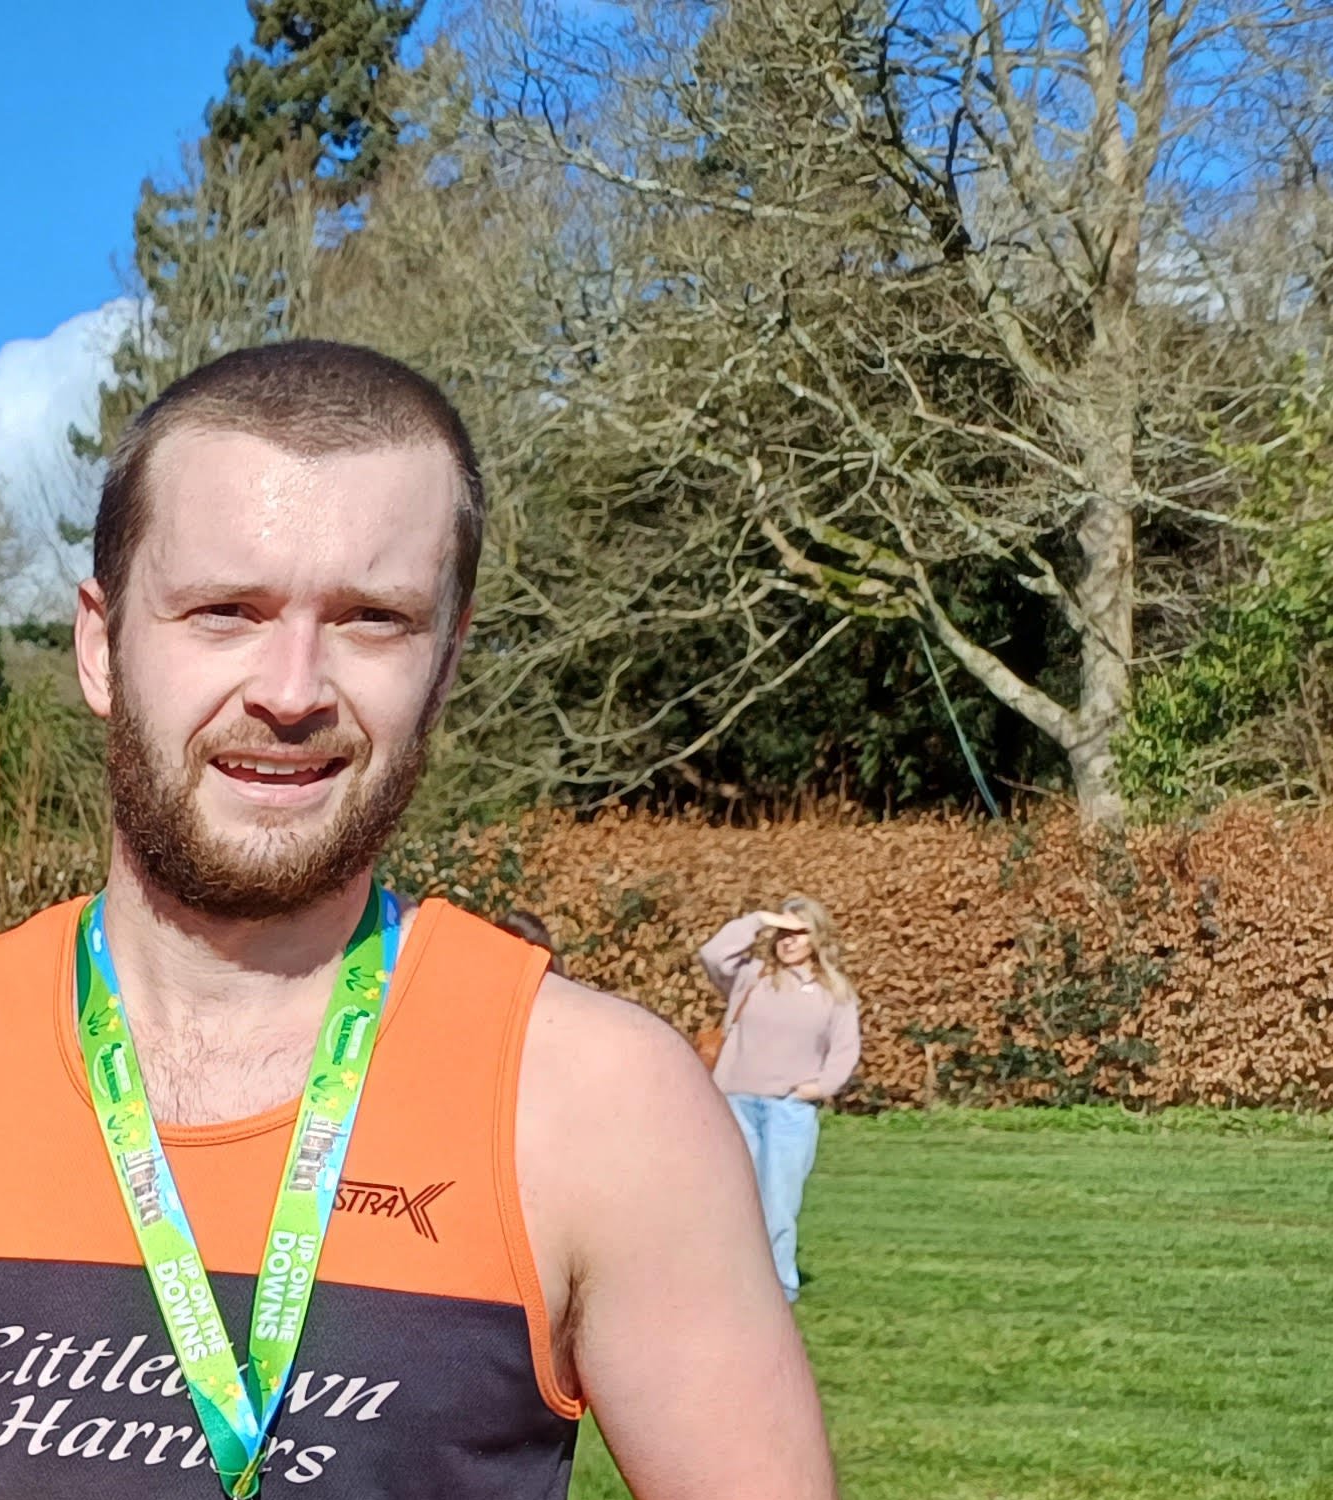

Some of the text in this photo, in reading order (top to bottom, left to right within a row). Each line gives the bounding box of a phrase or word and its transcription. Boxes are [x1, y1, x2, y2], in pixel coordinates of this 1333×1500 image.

[154, 1259, 209, 1363] DOWNS
[180, 1253, 226, 1354] UP ON THE
[255, 1231, 297, 1340] DOWNS
[277, 1234, 318, 1341] UP ON THE
